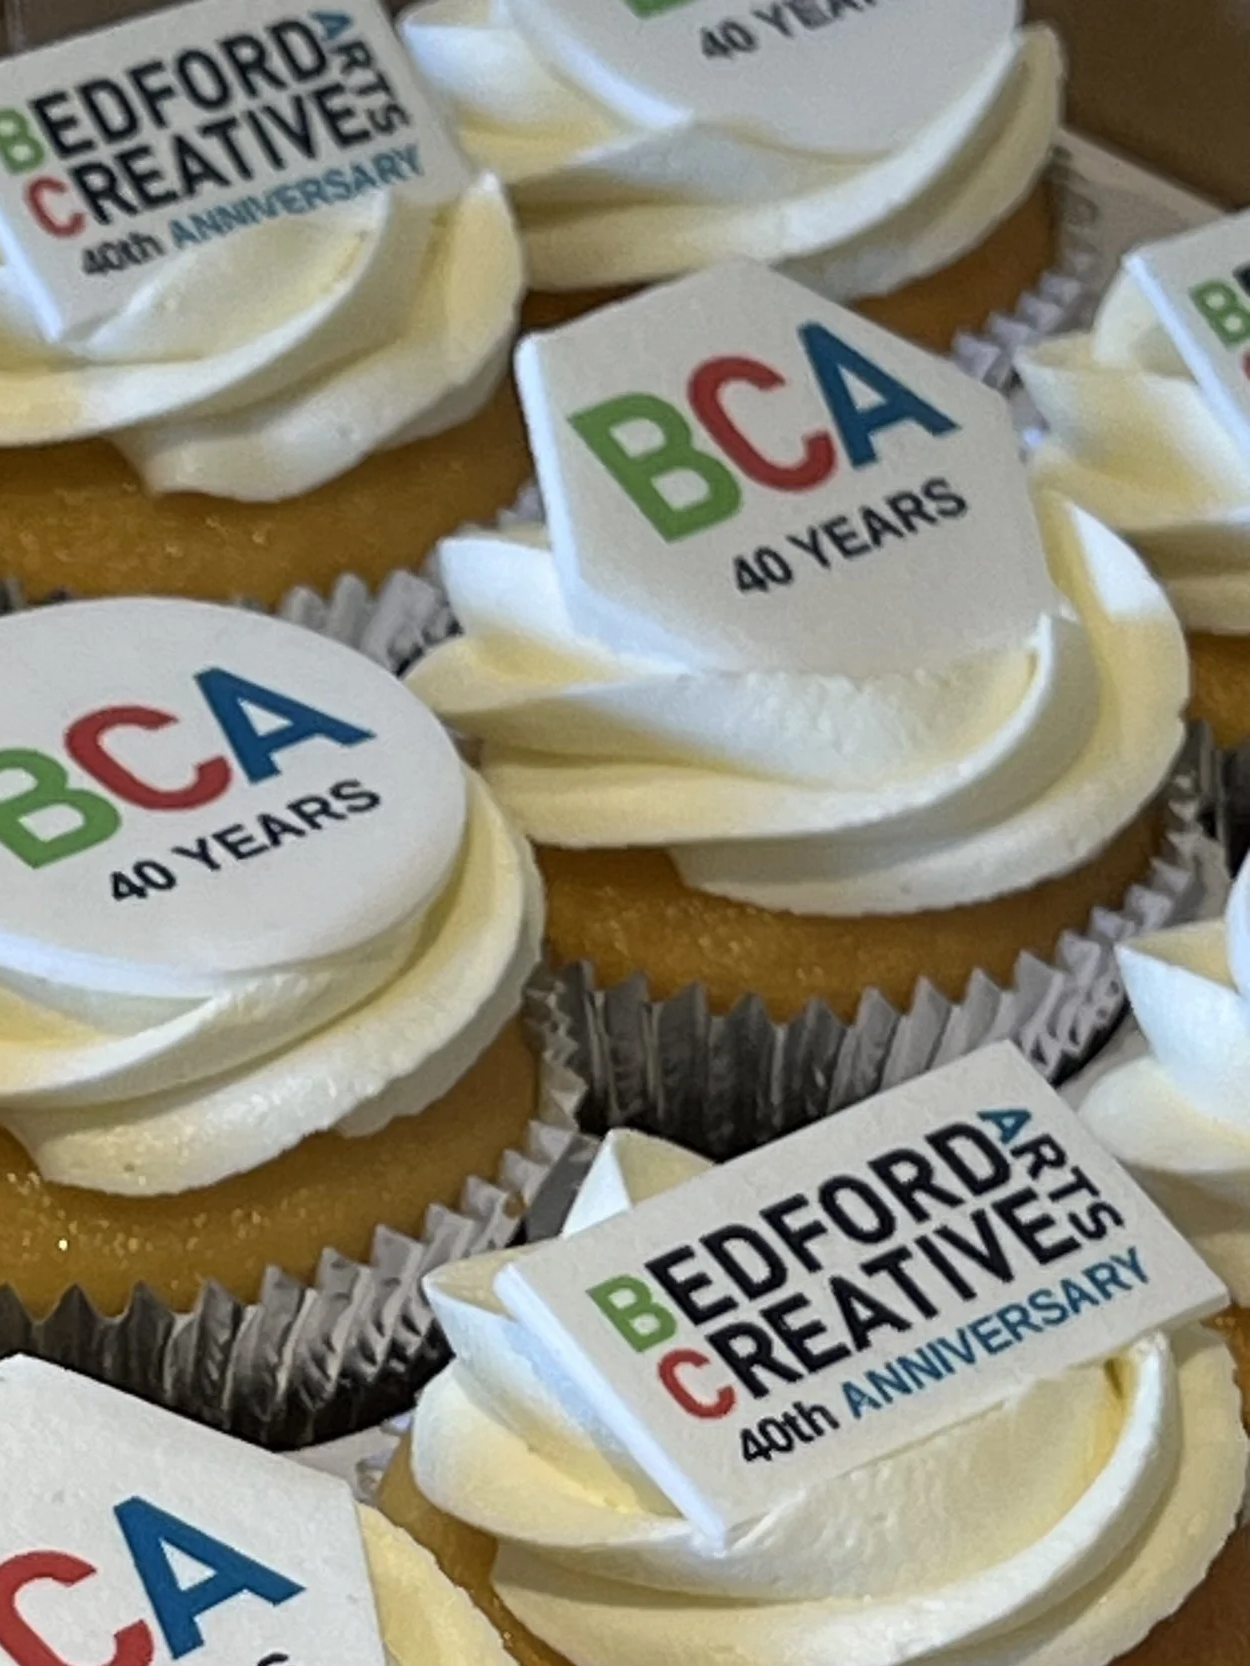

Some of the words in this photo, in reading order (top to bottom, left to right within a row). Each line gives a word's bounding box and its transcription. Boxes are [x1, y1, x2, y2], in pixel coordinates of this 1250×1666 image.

[308, 10, 412, 136] ARTS
[701, 18, 758, 60] 40
[24, 80, 382, 239] CREATIVE
[80, 231, 168, 277] 40th
[168, 143, 425, 250] ANNIVERSARY
[566, 321, 961, 545] BCA
[733, 545, 794, 595] 40
[786, 476, 970, 576] YEARS
[108, 860, 177, 902] 40
[172, 779, 382, 873] YEARS
[586, 1121, 1014, 1354] BEDFORD
[978, 1105, 1125, 1244] ARTS
[657, 1185, 1083, 1422] CREATIVE
[739, 1403, 841, 1464] 40th
[840, 1245, 1150, 1422] ANNIVERSARY
